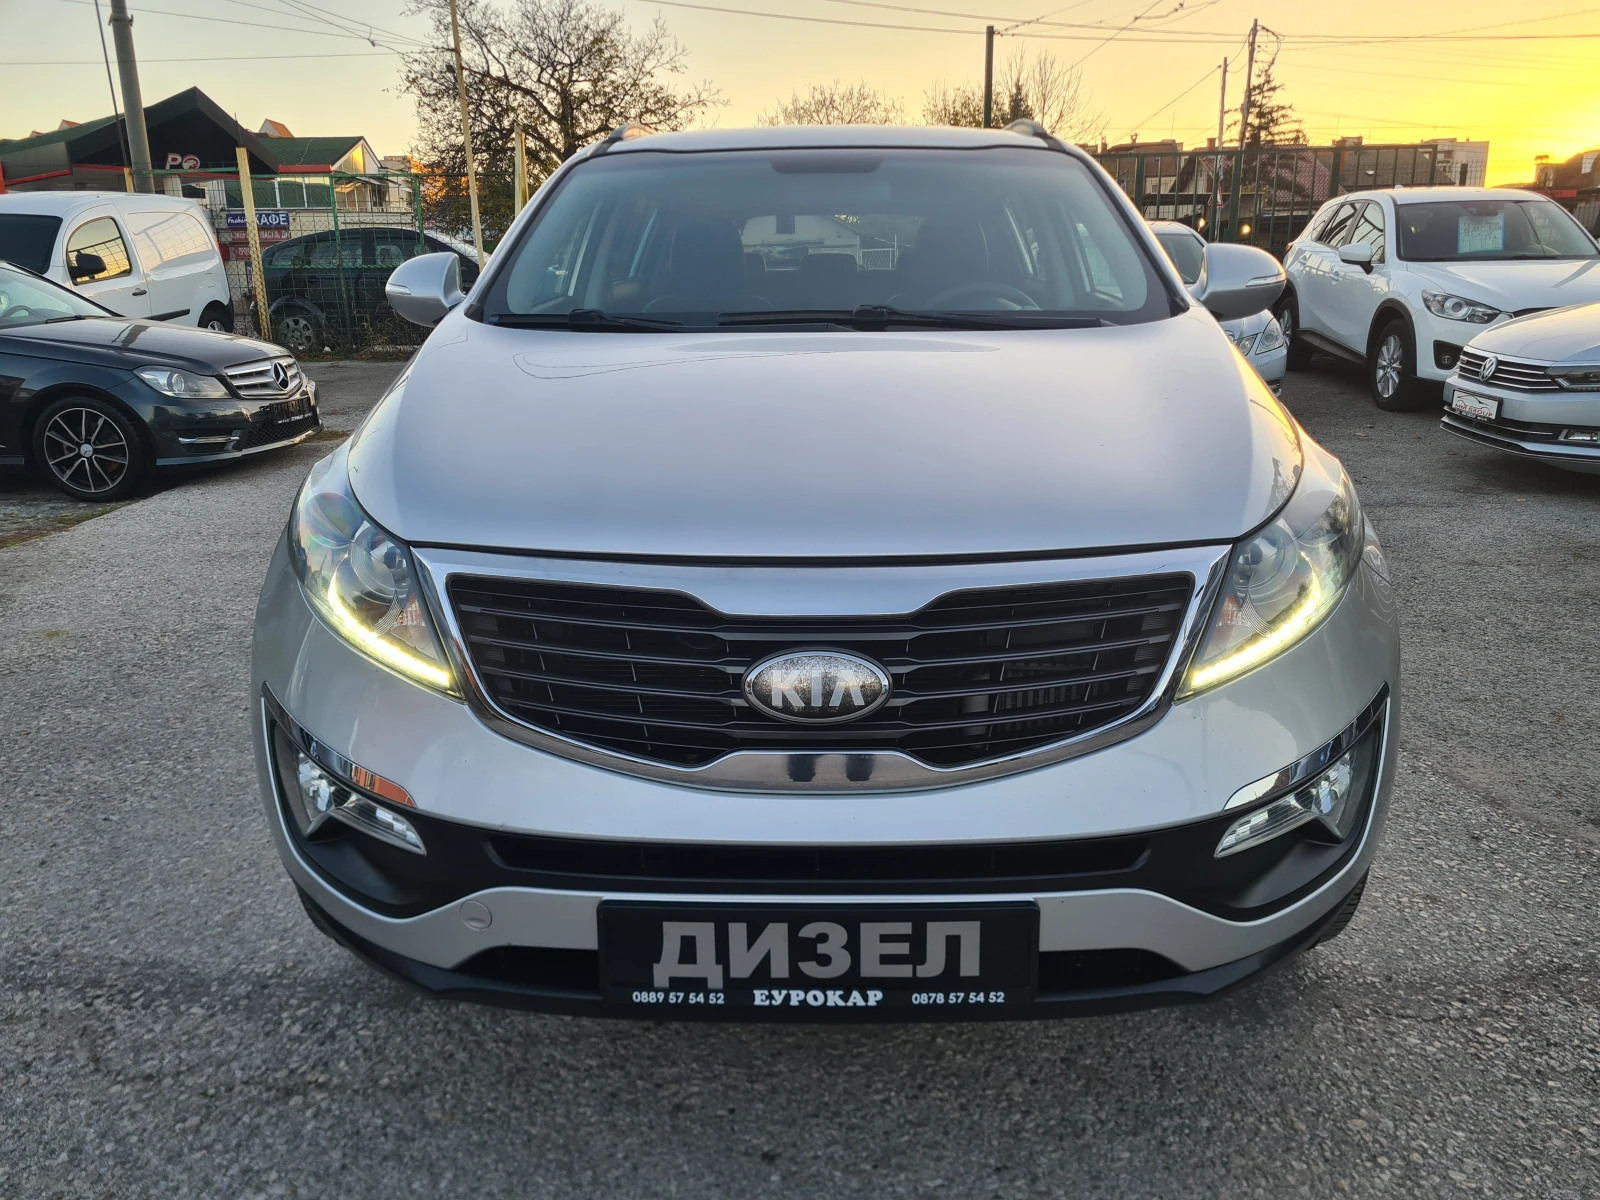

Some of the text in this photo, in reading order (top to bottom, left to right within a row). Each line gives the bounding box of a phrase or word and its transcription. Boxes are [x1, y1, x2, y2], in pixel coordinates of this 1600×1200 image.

[771, 669, 865, 707] KIA
[653, 920, 981, 989] ДИЗЕЛ
[632, 991, 725, 1005] 0889 57 54 52
[753, 989, 884, 1007] ЕУРОКАР
[911, 991, 1005, 1005] 0878 57 54 52
